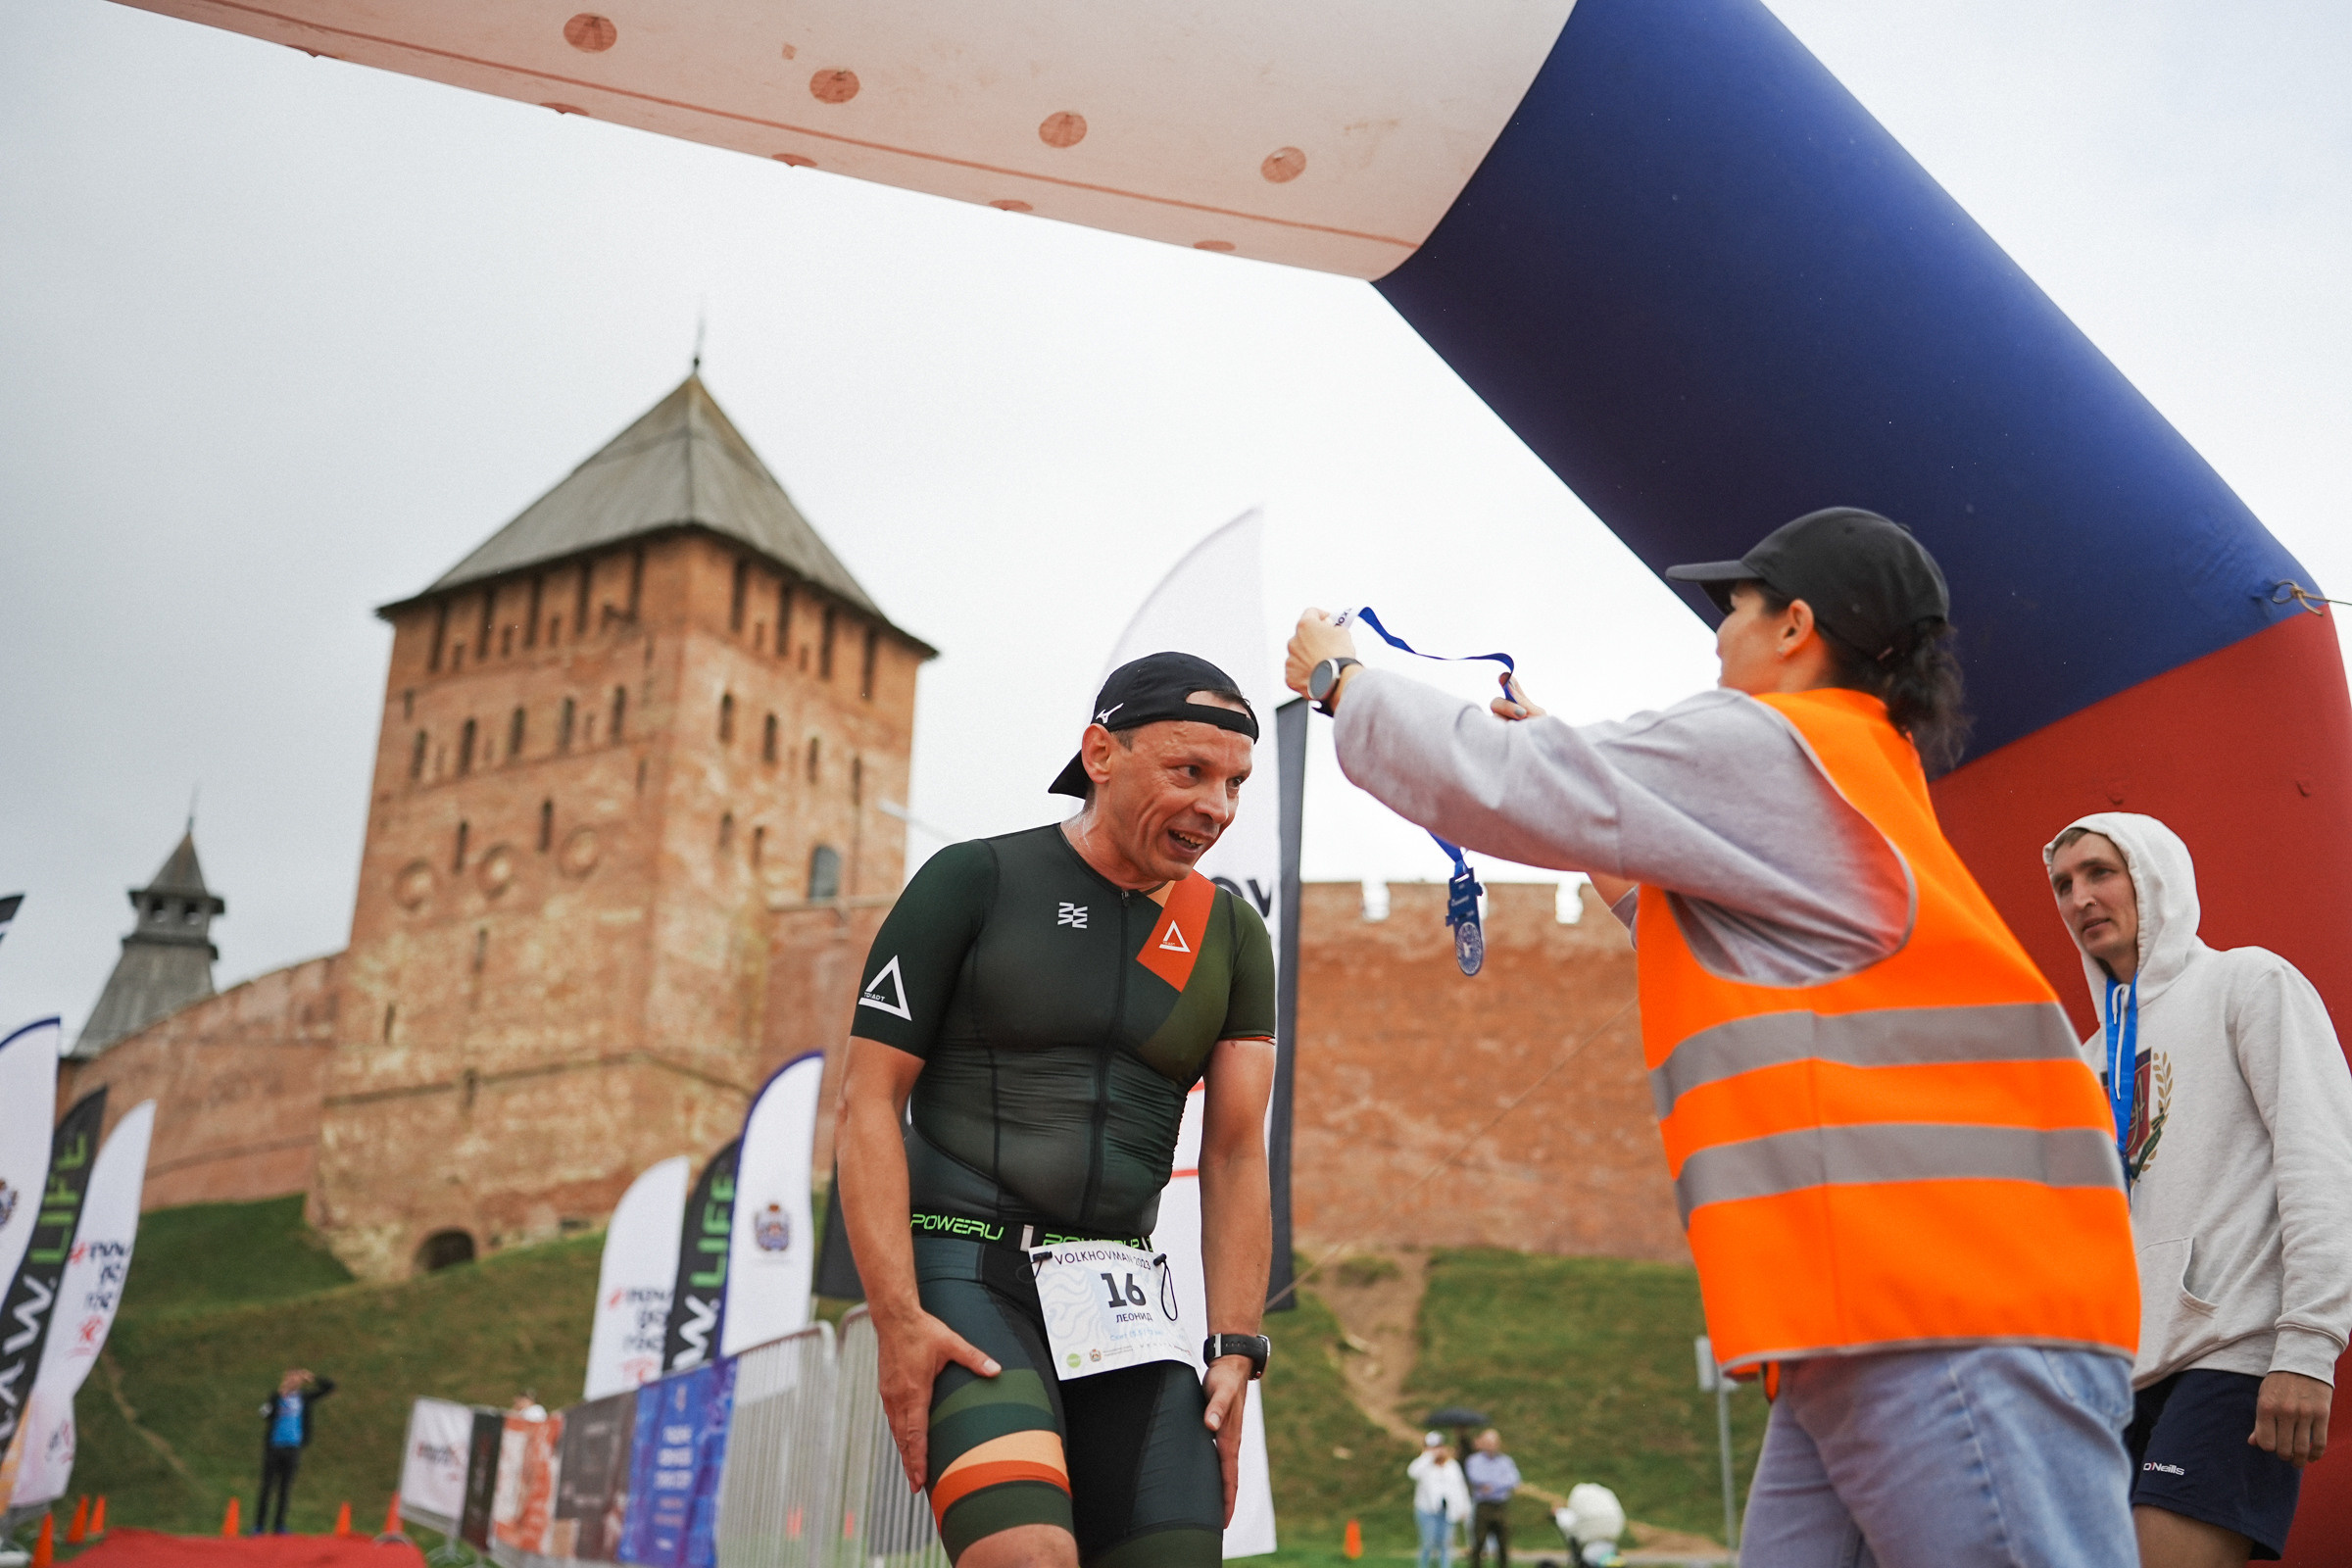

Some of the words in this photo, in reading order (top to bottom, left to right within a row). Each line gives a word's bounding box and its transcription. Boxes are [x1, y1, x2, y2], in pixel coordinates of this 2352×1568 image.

[1054, 1250, 1133, 1265] VOLKHOVMAN
[1100, 1272, 1147, 1308] 16
[1116, 1312, 1153, 1323] ЛЕОНИД
